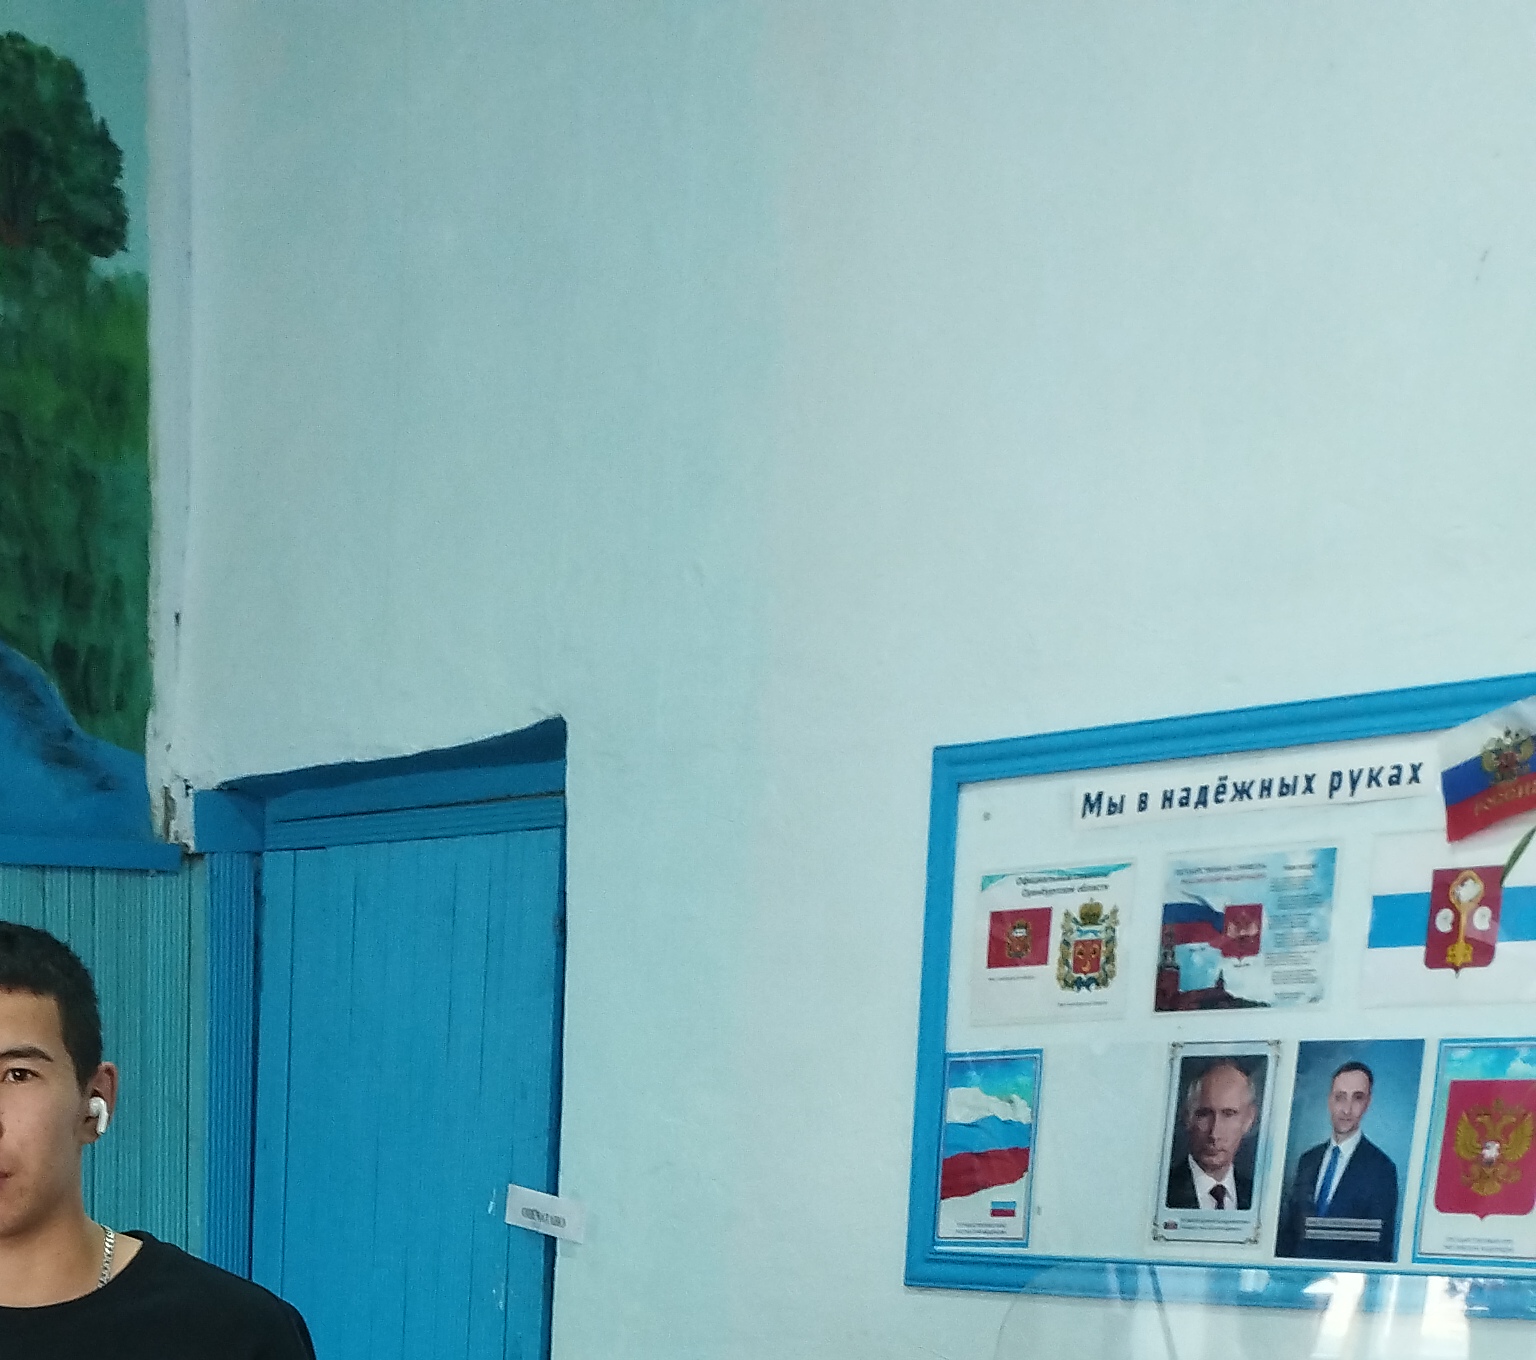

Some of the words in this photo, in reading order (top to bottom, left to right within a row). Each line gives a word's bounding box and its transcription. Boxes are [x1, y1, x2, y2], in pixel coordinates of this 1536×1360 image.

[1081, 791, 1126, 819] Мы
[1137, 792, 1150, 813] в
[1160, 773, 1316, 811] надёжных
[1328, 761, 1424, 800] руках
